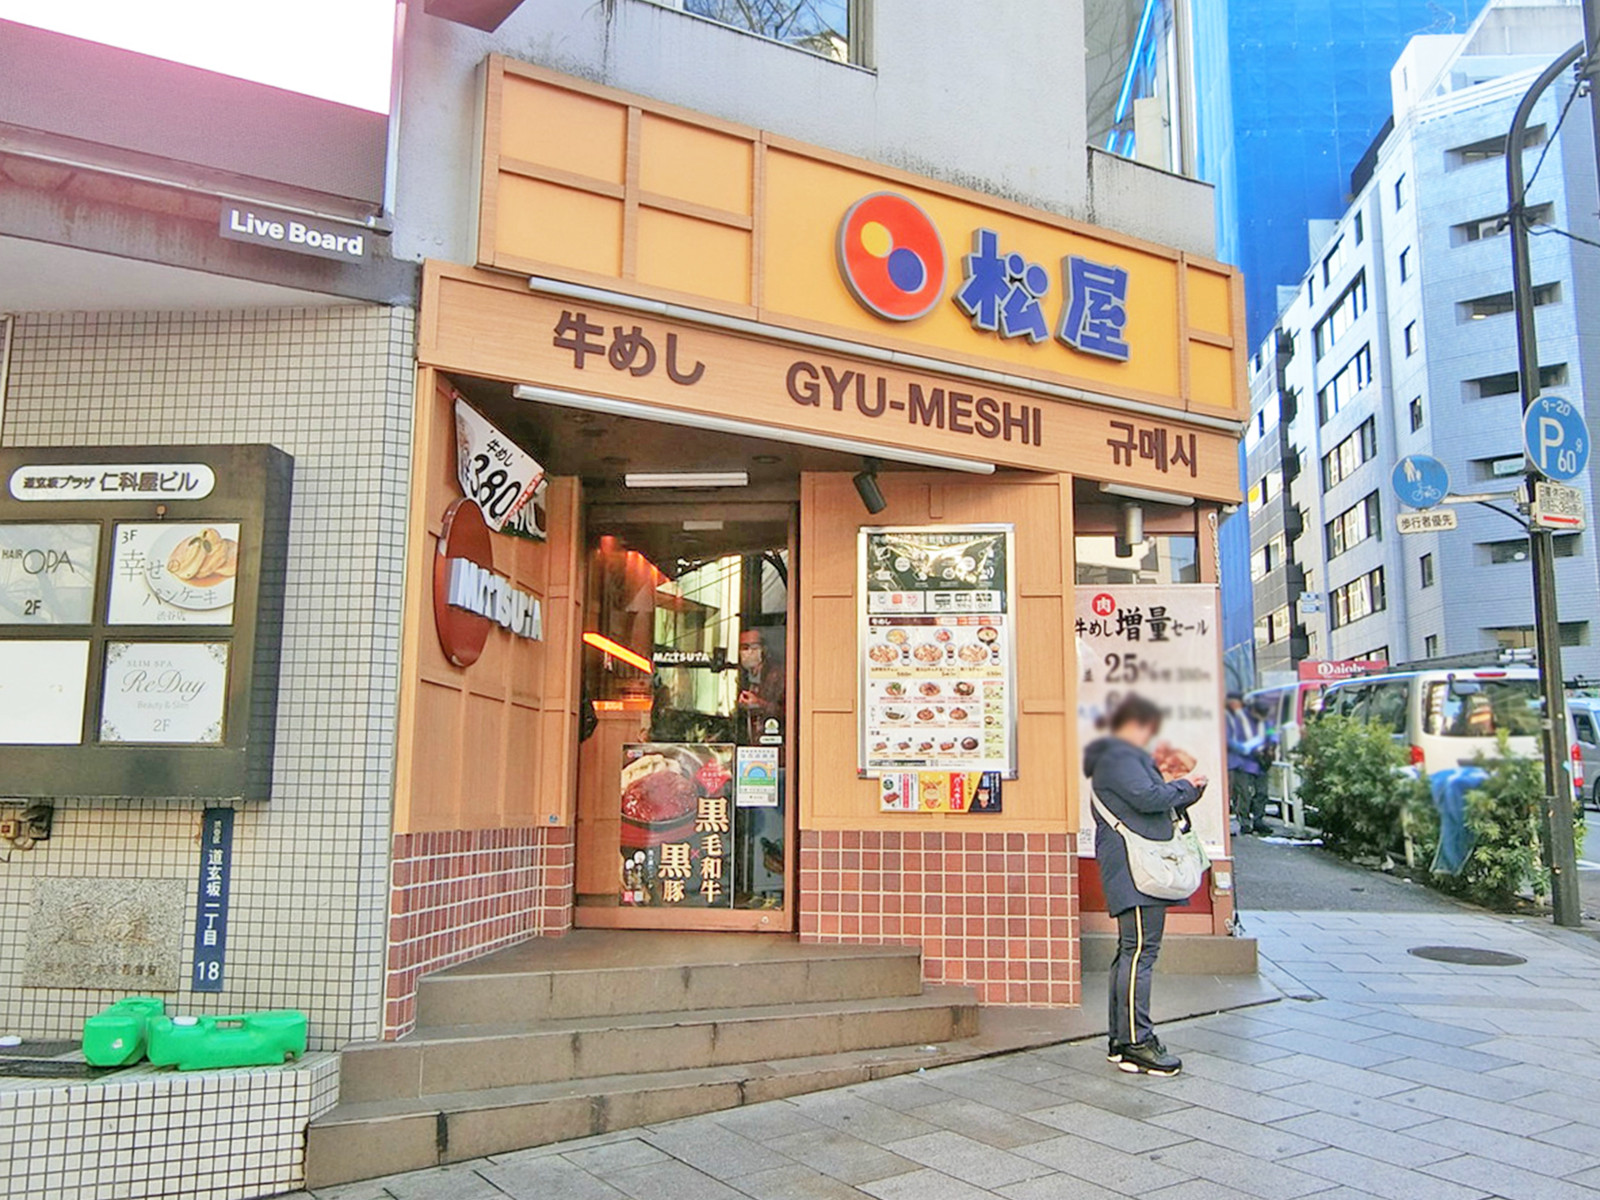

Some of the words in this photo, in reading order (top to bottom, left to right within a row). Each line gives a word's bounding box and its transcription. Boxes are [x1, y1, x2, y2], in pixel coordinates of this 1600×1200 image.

[230, 209, 285, 240] Live
[289, 221, 364, 256] Board
[952, 228, 1130, 364] 松屋
[553, 310, 706, 386] 牛めし
[786, 361, 1042, 447] GYU-MESHI
[1542, 400, 1572, 417] 9-20
[486, 439, 514, 468] 牛めし
[1106, 420, 1197, 478] 규메시
[1538, 416, 1565, 470] P
[100, 472, 199, 492] 仁科屋ビル
[470, 454, 522, 519] 380
[1401, 514, 1453, 530] 歩行者優先
[121, 529, 139, 545] 3F
[1, 549, 24, 559] HAIR
[23, 549, 75, 575] OPA
[119, 549, 165, 581] 幸せ
[24, 600, 42, 616] 2F
[142, 586, 218, 607] パンケーキ
[1096, 597, 1112, 613] 肉
[127, 660, 151, 668] SLIM
[152, 719, 172, 732] 2F
[695, 797, 730, 904] 黒毛和牛
[658, 842, 692, 903] 黒豚
[197, 961, 220, 981] 18
